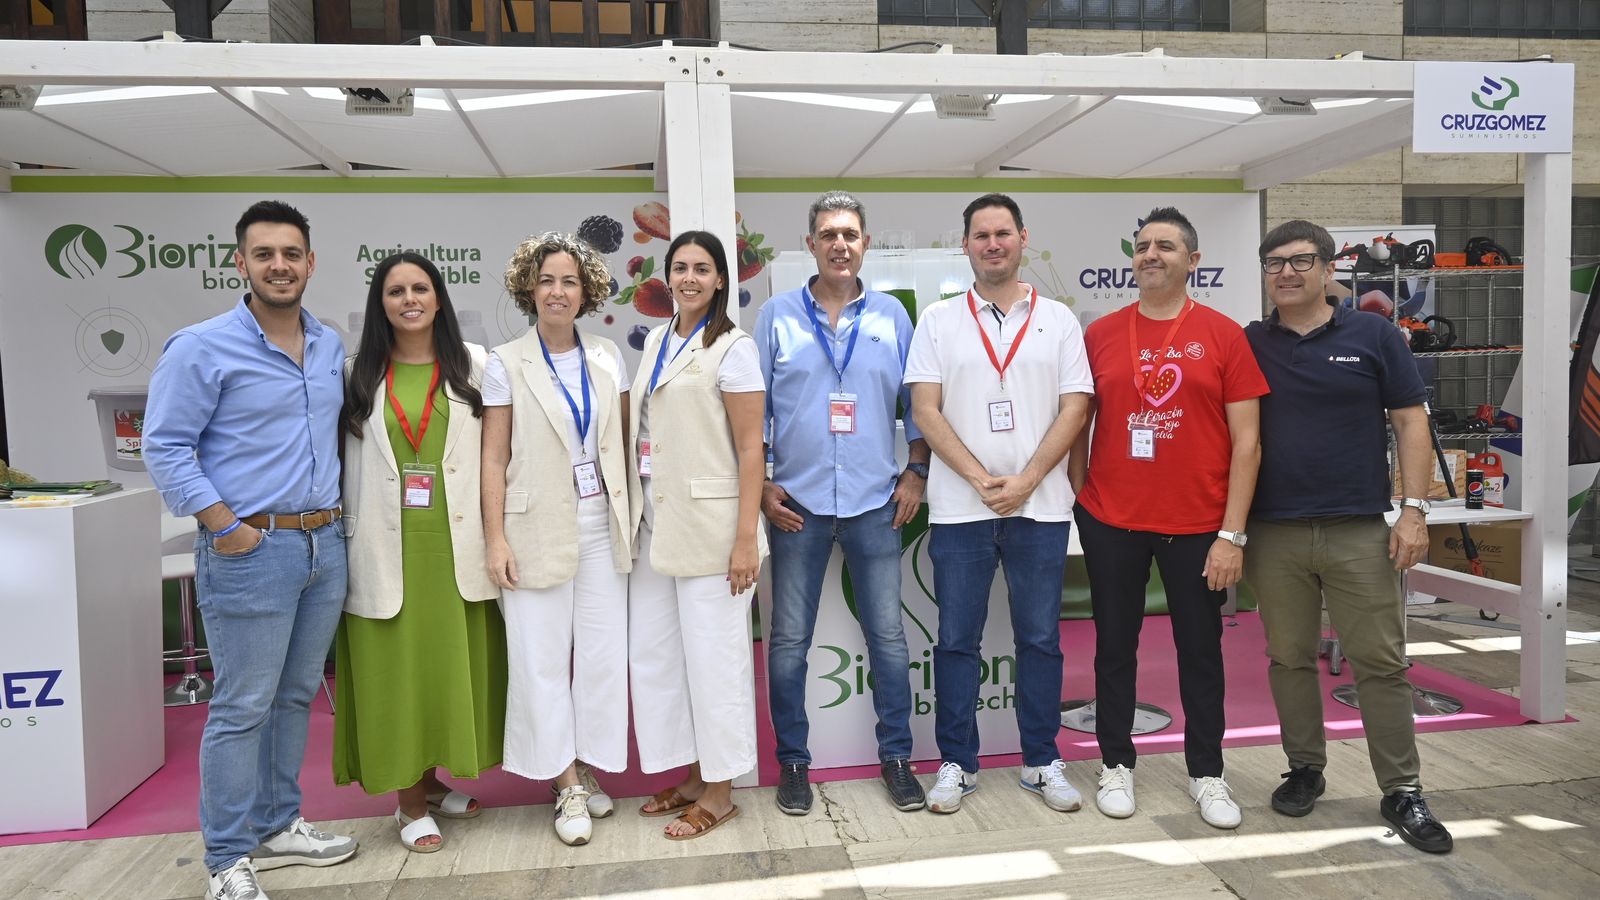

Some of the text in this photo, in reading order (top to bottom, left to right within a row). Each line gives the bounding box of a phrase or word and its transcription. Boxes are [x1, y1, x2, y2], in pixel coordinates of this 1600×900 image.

[1441, 114, 1546, 130] CRUZGOMEZ
[113, 224, 239, 278] Bioriz
[364, 266, 480, 285] Sible
[1079, 267, 1224, 289] CRUZMEZ
[1093, 291, 1211, 299] SUMIOS
[0, 670, 64, 709] EZ
